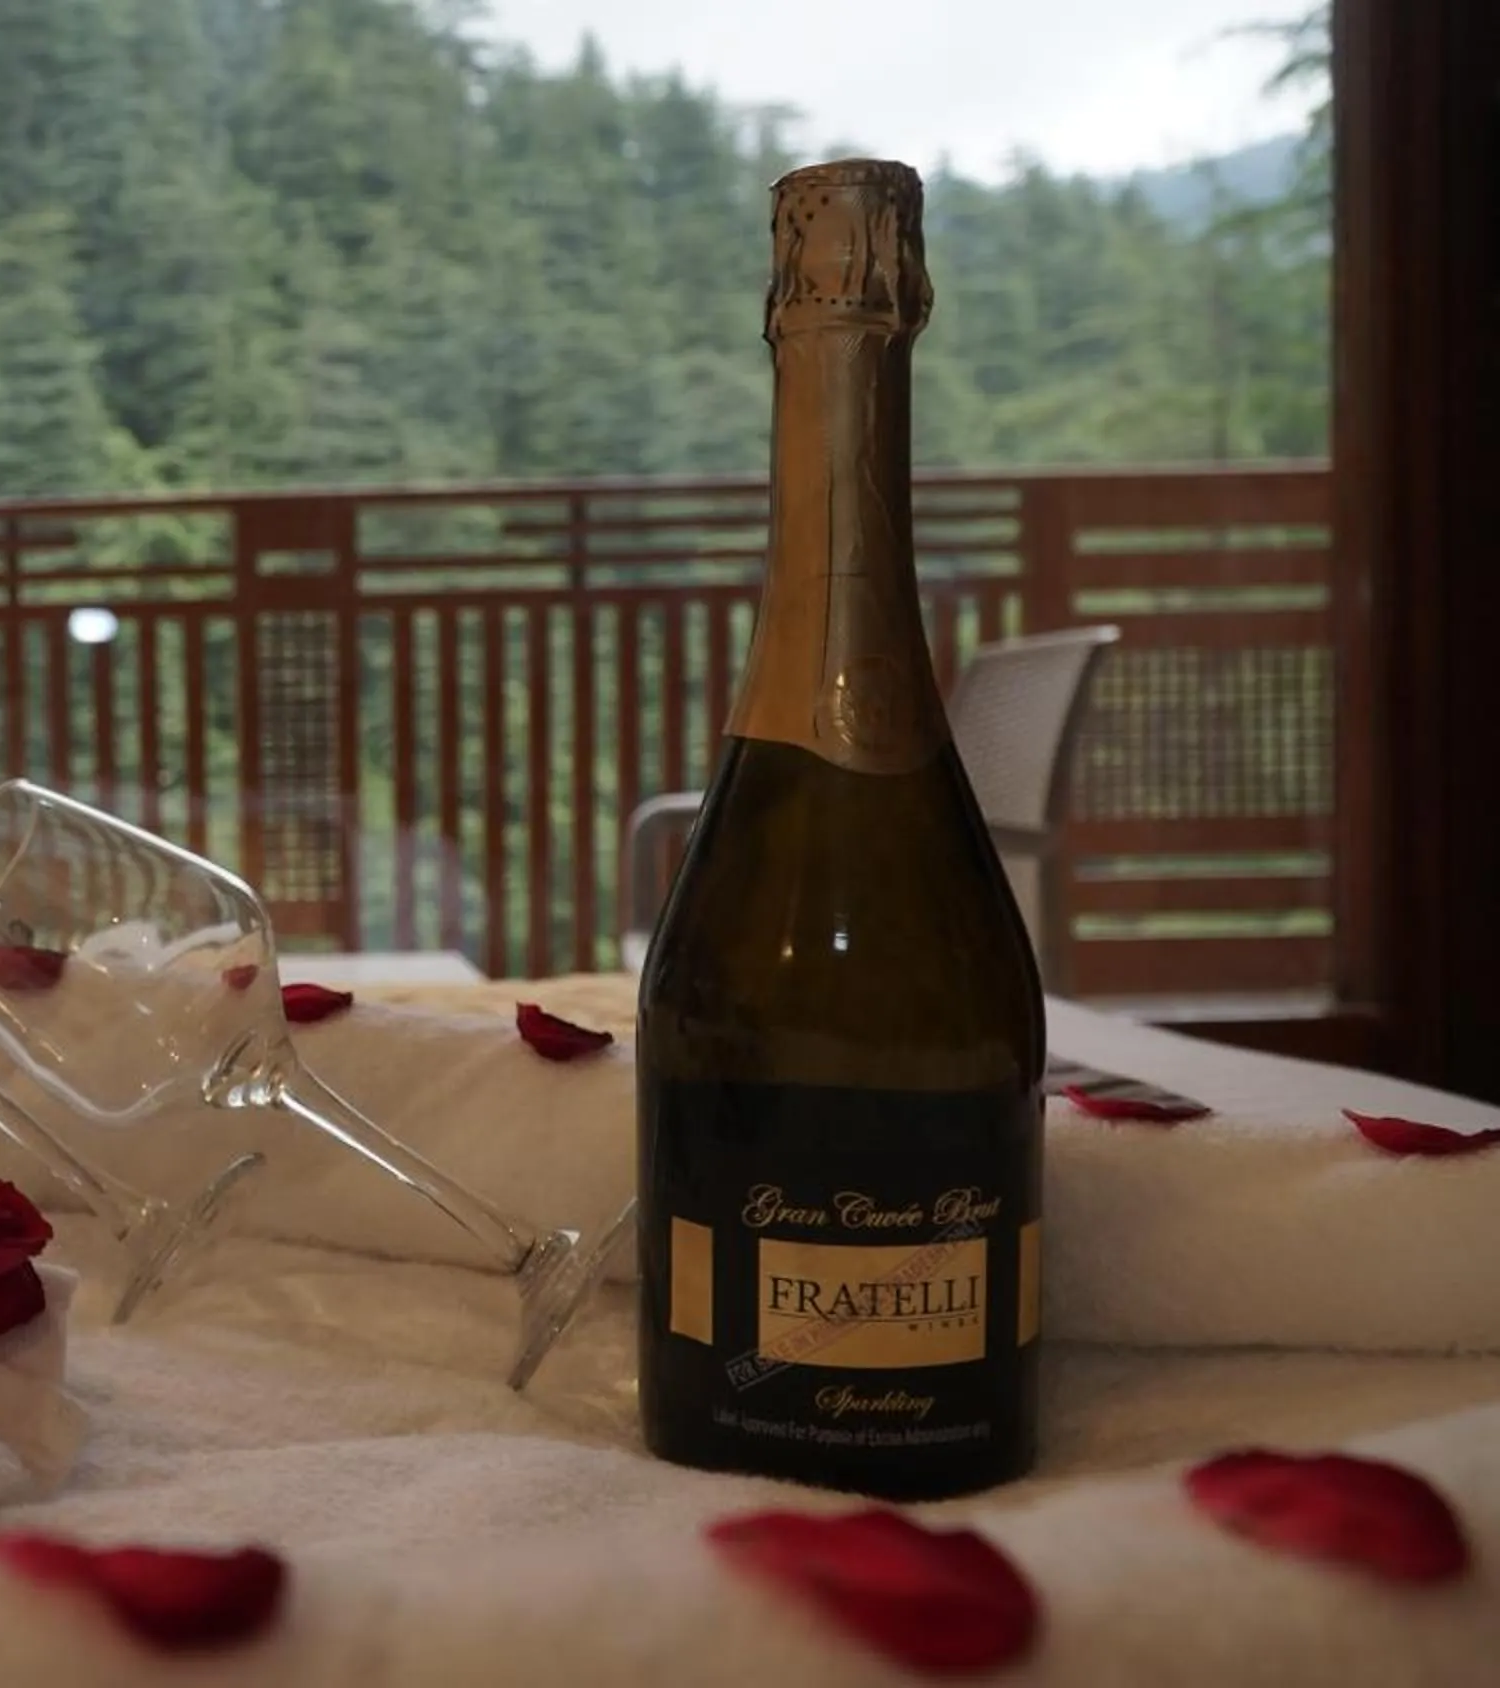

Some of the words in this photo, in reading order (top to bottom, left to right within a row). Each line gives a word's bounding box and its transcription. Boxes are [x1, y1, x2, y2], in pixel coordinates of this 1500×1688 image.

[742, 1184, 827, 1227] Gran
[834, 1191, 924, 1229] Cuvée
[933, 1186, 1001, 1226] Brut
[769, 1275, 980, 1321] FRATELLI
[815, 1385, 935, 1420] Sparkling
